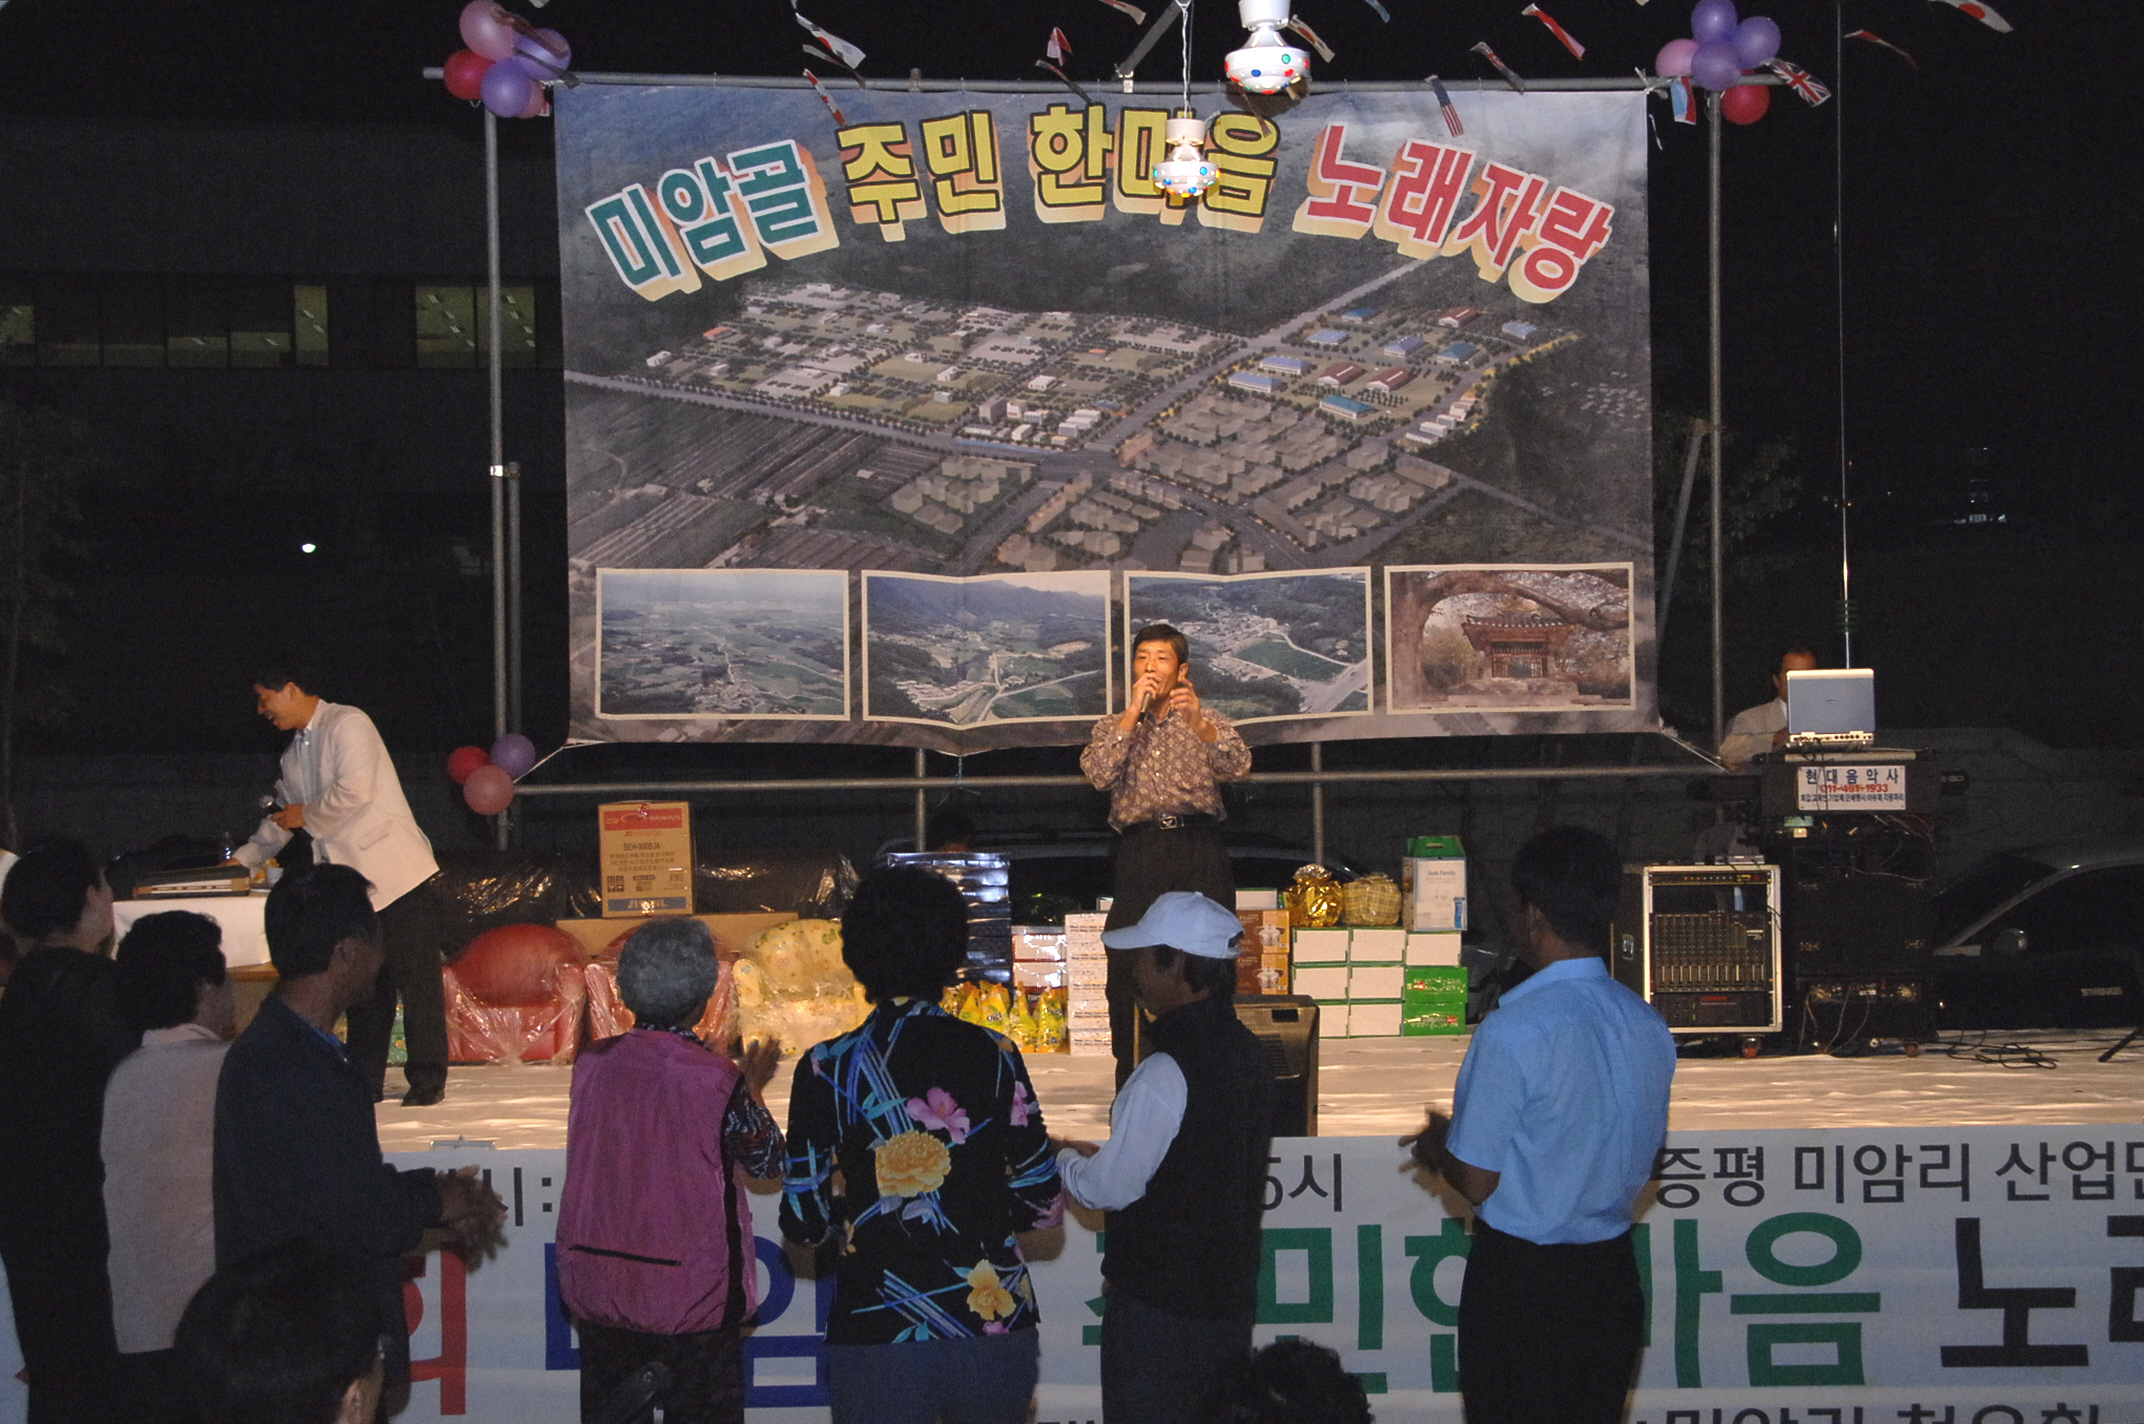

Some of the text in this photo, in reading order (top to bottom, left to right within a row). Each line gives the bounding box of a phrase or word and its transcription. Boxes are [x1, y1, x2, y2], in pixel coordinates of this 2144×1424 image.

[585, 139, 828, 291] 미암골
[836, 109, 1001, 225] 주민
[1303, 122, 1614, 292] 노래자랑
[1806, 768, 1899, 784] 현대음악사
[1655, 1146, 1765, 1208] 증평
[1794, 1143, 1970, 1204] 미암리
[1995, 1141, 2144, 1203] 산업
[1940, 1214, 2144, 1368] 노
